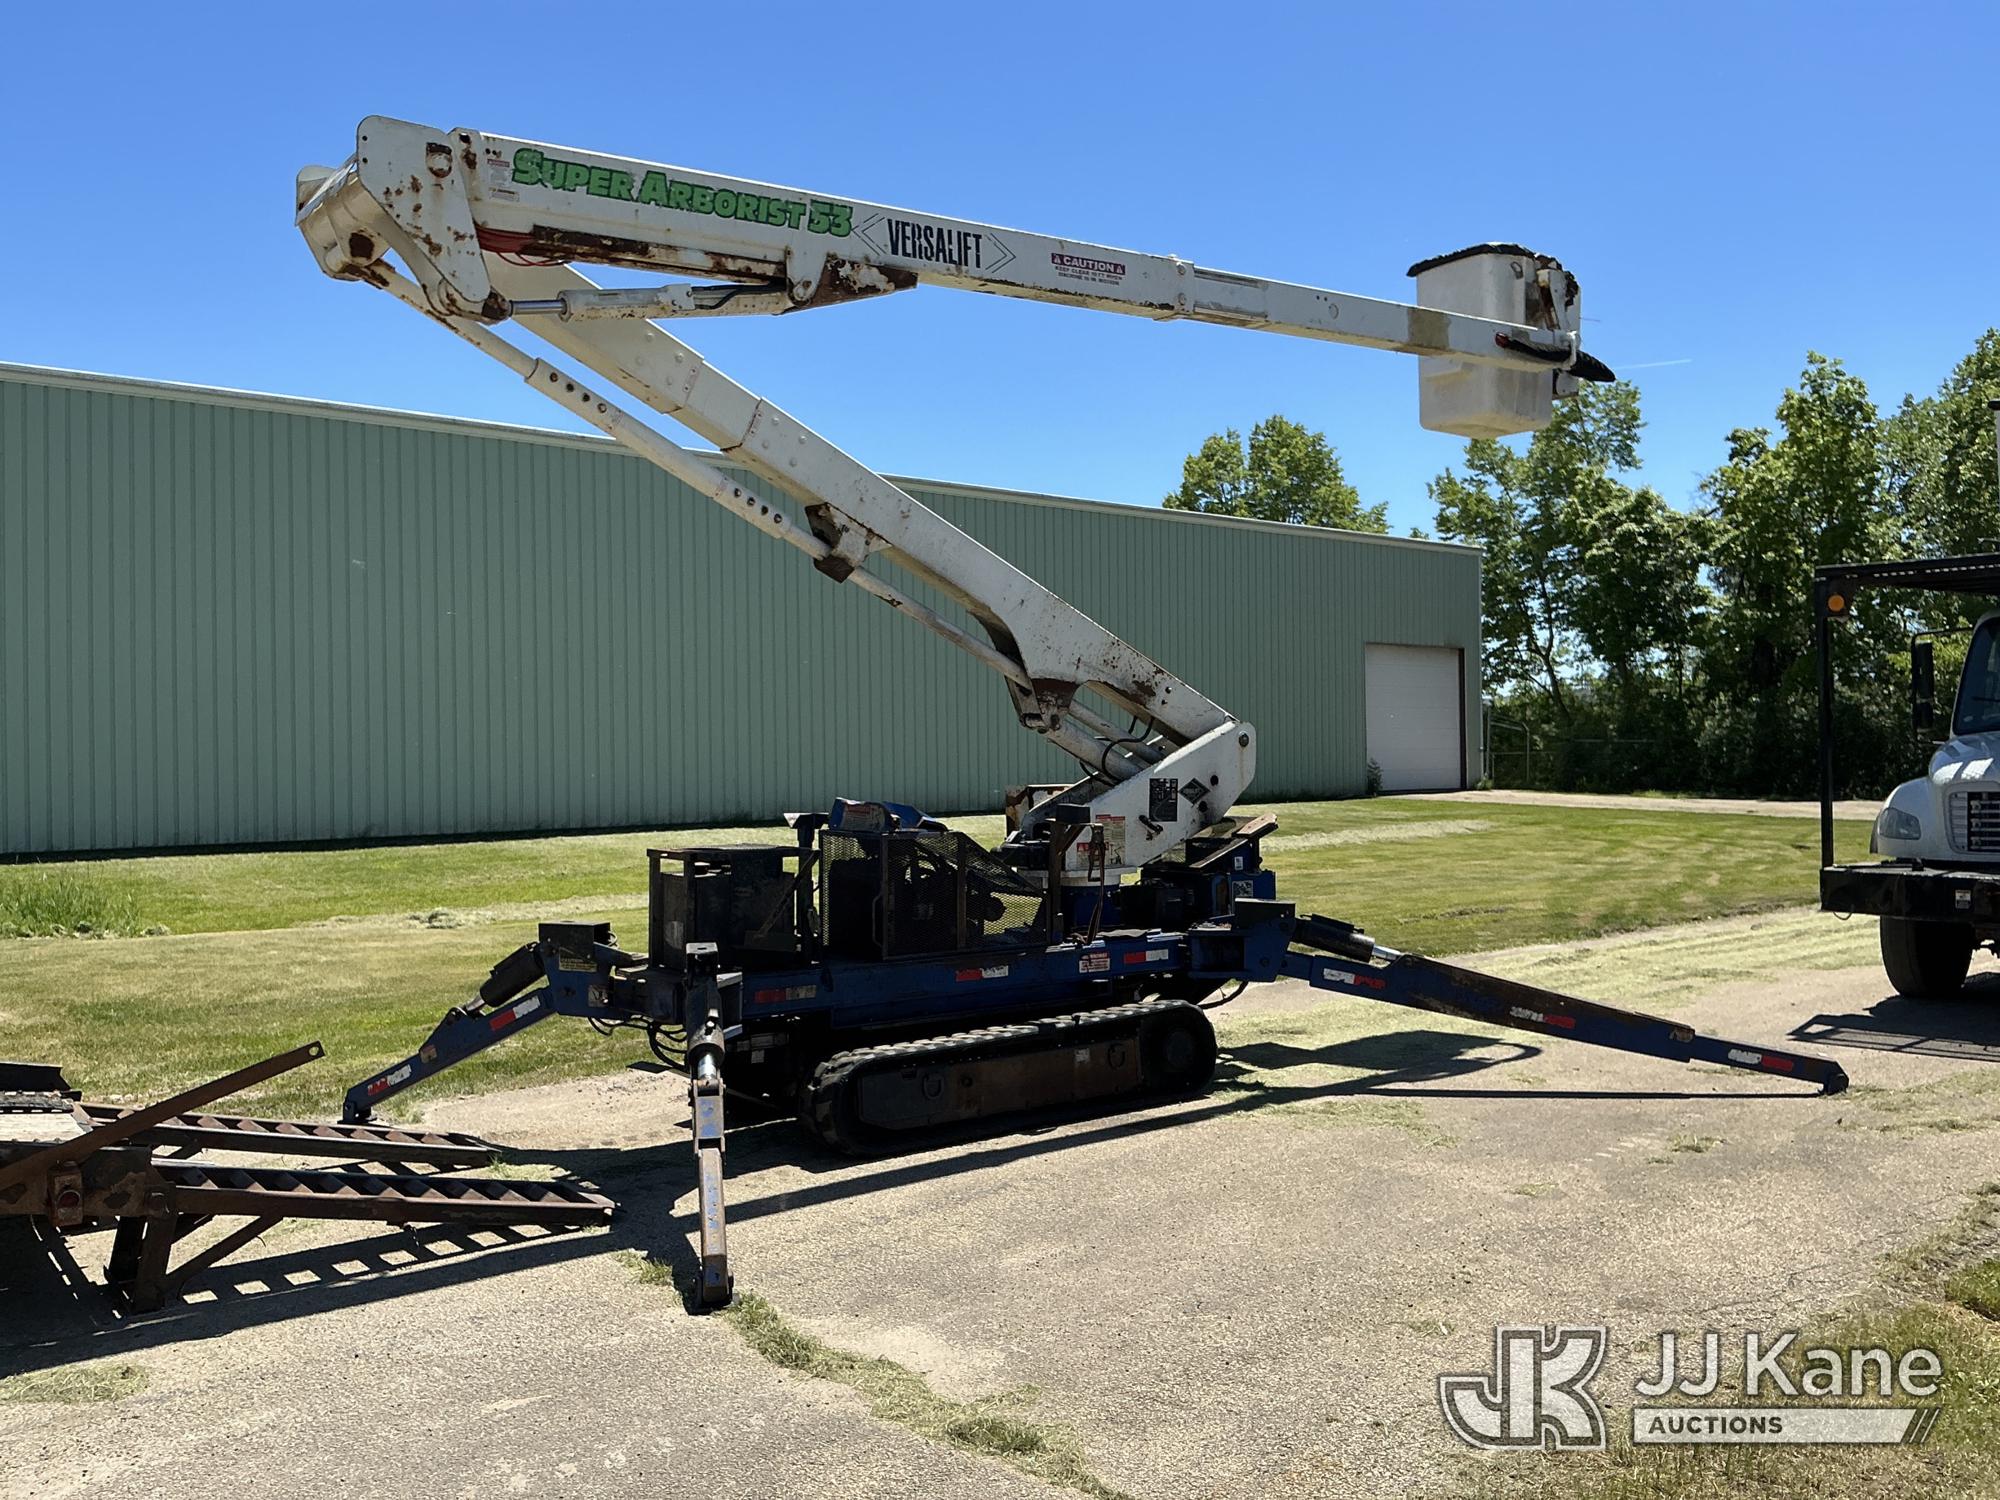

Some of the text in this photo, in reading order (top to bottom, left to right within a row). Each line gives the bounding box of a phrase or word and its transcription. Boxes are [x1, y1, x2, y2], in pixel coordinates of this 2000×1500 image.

[512, 148, 853, 237] SUPER ARBORIST 53
[887, 218, 982, 268] VERSALIFT
[1063, 256, 1115, 273] CAUTION
